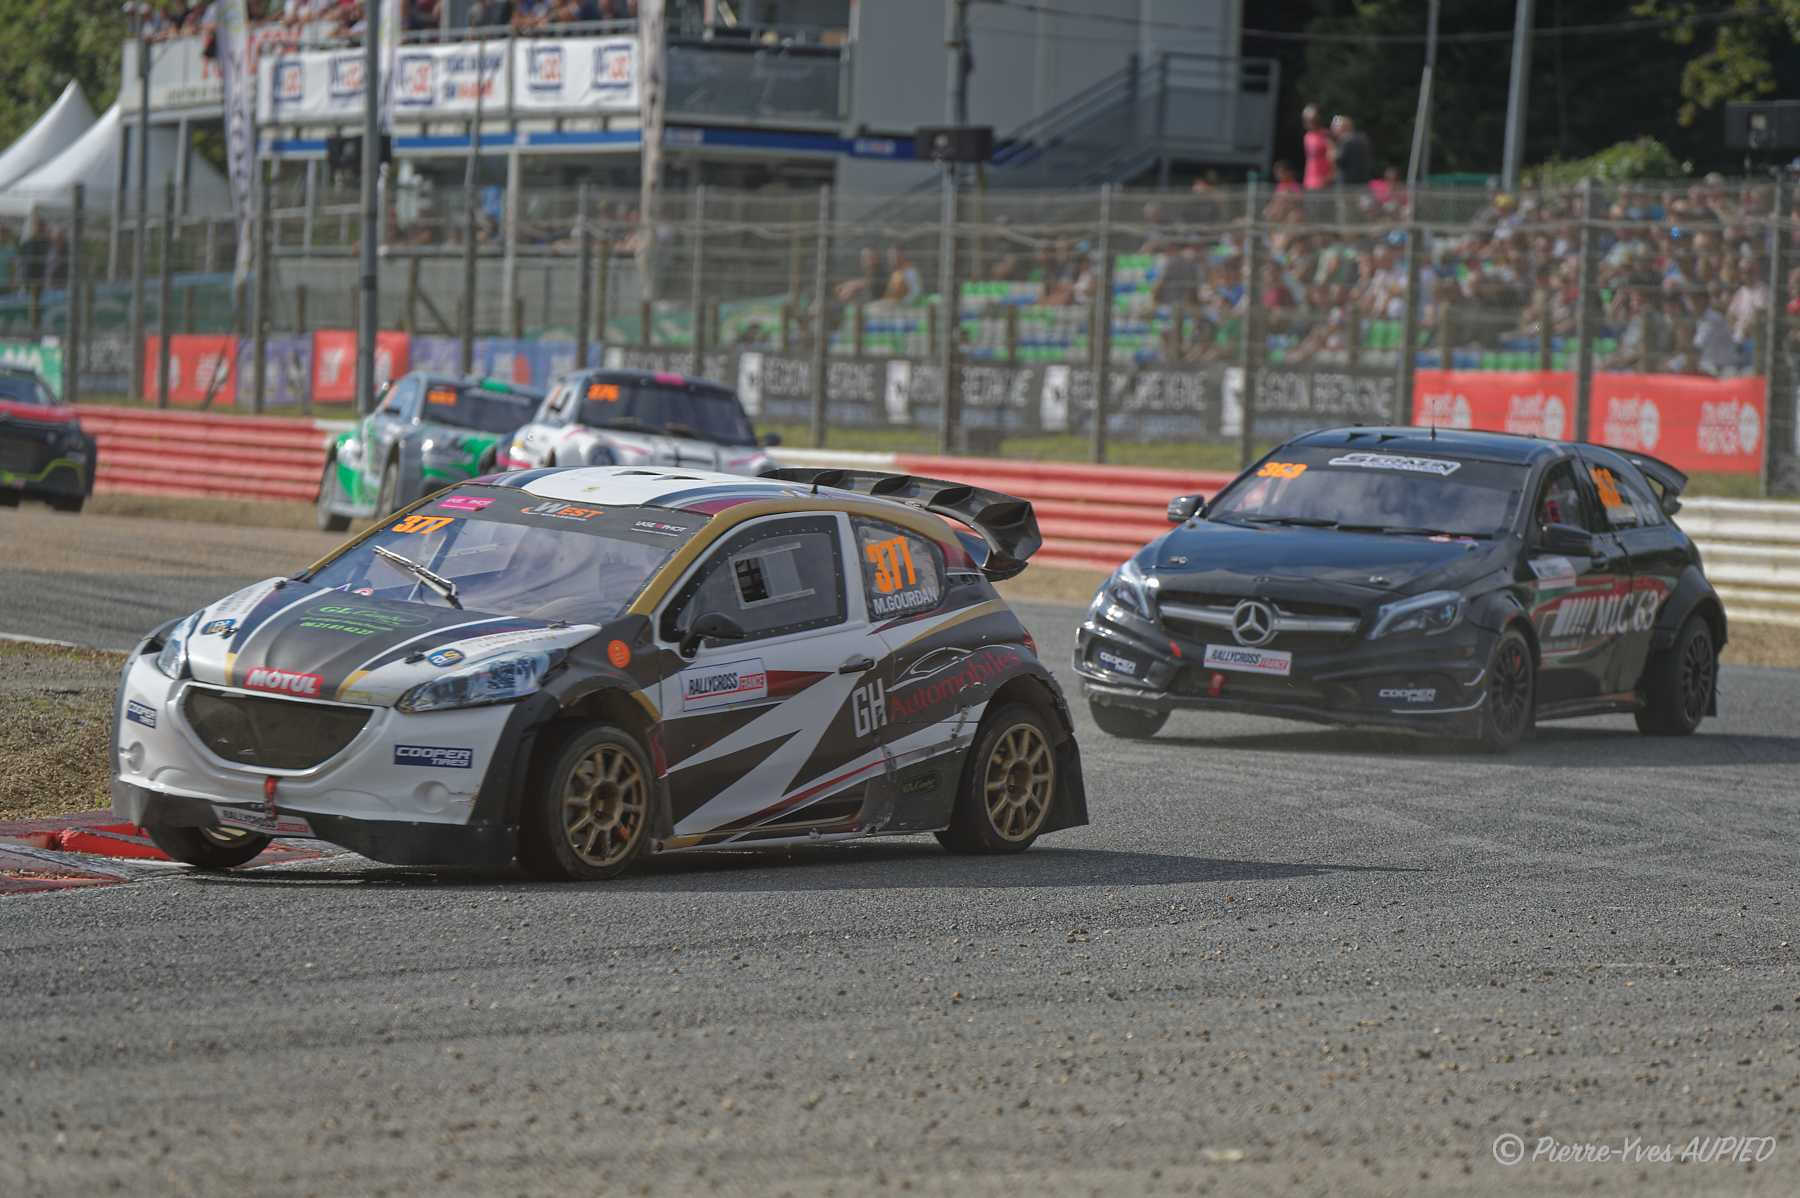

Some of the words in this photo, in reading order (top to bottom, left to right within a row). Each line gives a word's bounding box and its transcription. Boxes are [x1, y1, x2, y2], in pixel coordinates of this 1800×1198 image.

[391, 514, 455, 536] 377
[865, 536, 917, 593] 377
[1212, 649, 1261, 666] RALLYCROSS
[246, 668, 319, 694] MOTUL
[688, 671, 739, 696] RALLYCROSS
[1379, 688, 1437, 702] COOPER
[851, 678, 888, 738] GH
[396, 746, 471, 760] COOPER
[431, 757, 469, 767] TIRES
